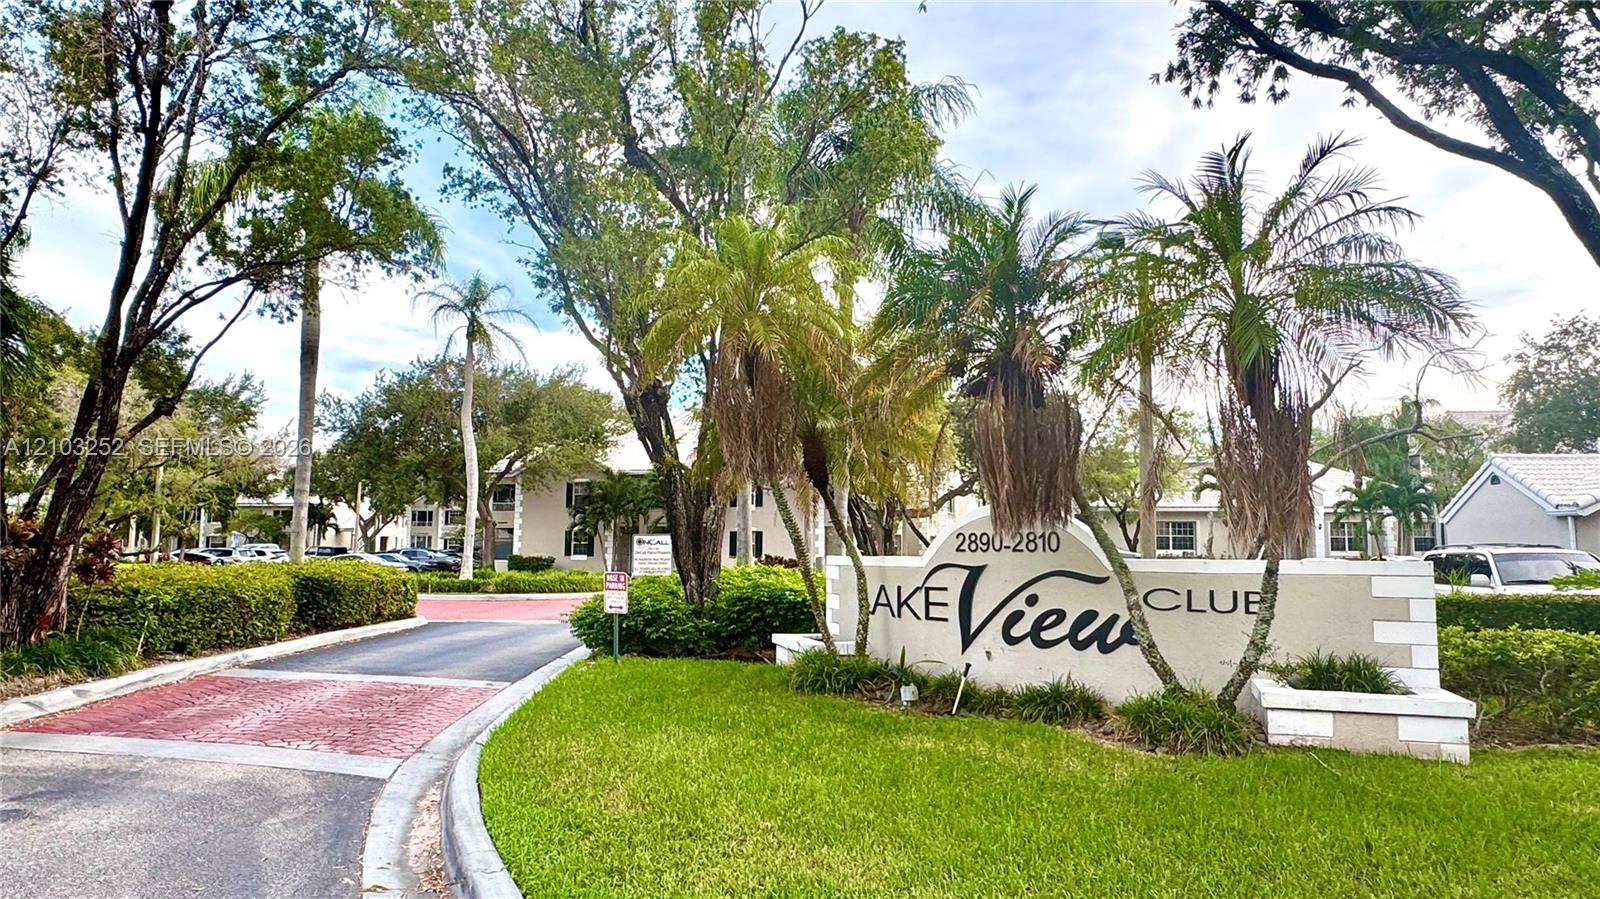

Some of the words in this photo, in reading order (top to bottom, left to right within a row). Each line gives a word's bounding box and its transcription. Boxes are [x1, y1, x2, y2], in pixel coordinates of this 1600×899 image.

[955, 531, 1060, 553] 2890-2810
[869, 583, 949, 623] AKE
[921, 562, 1139, 655] View
